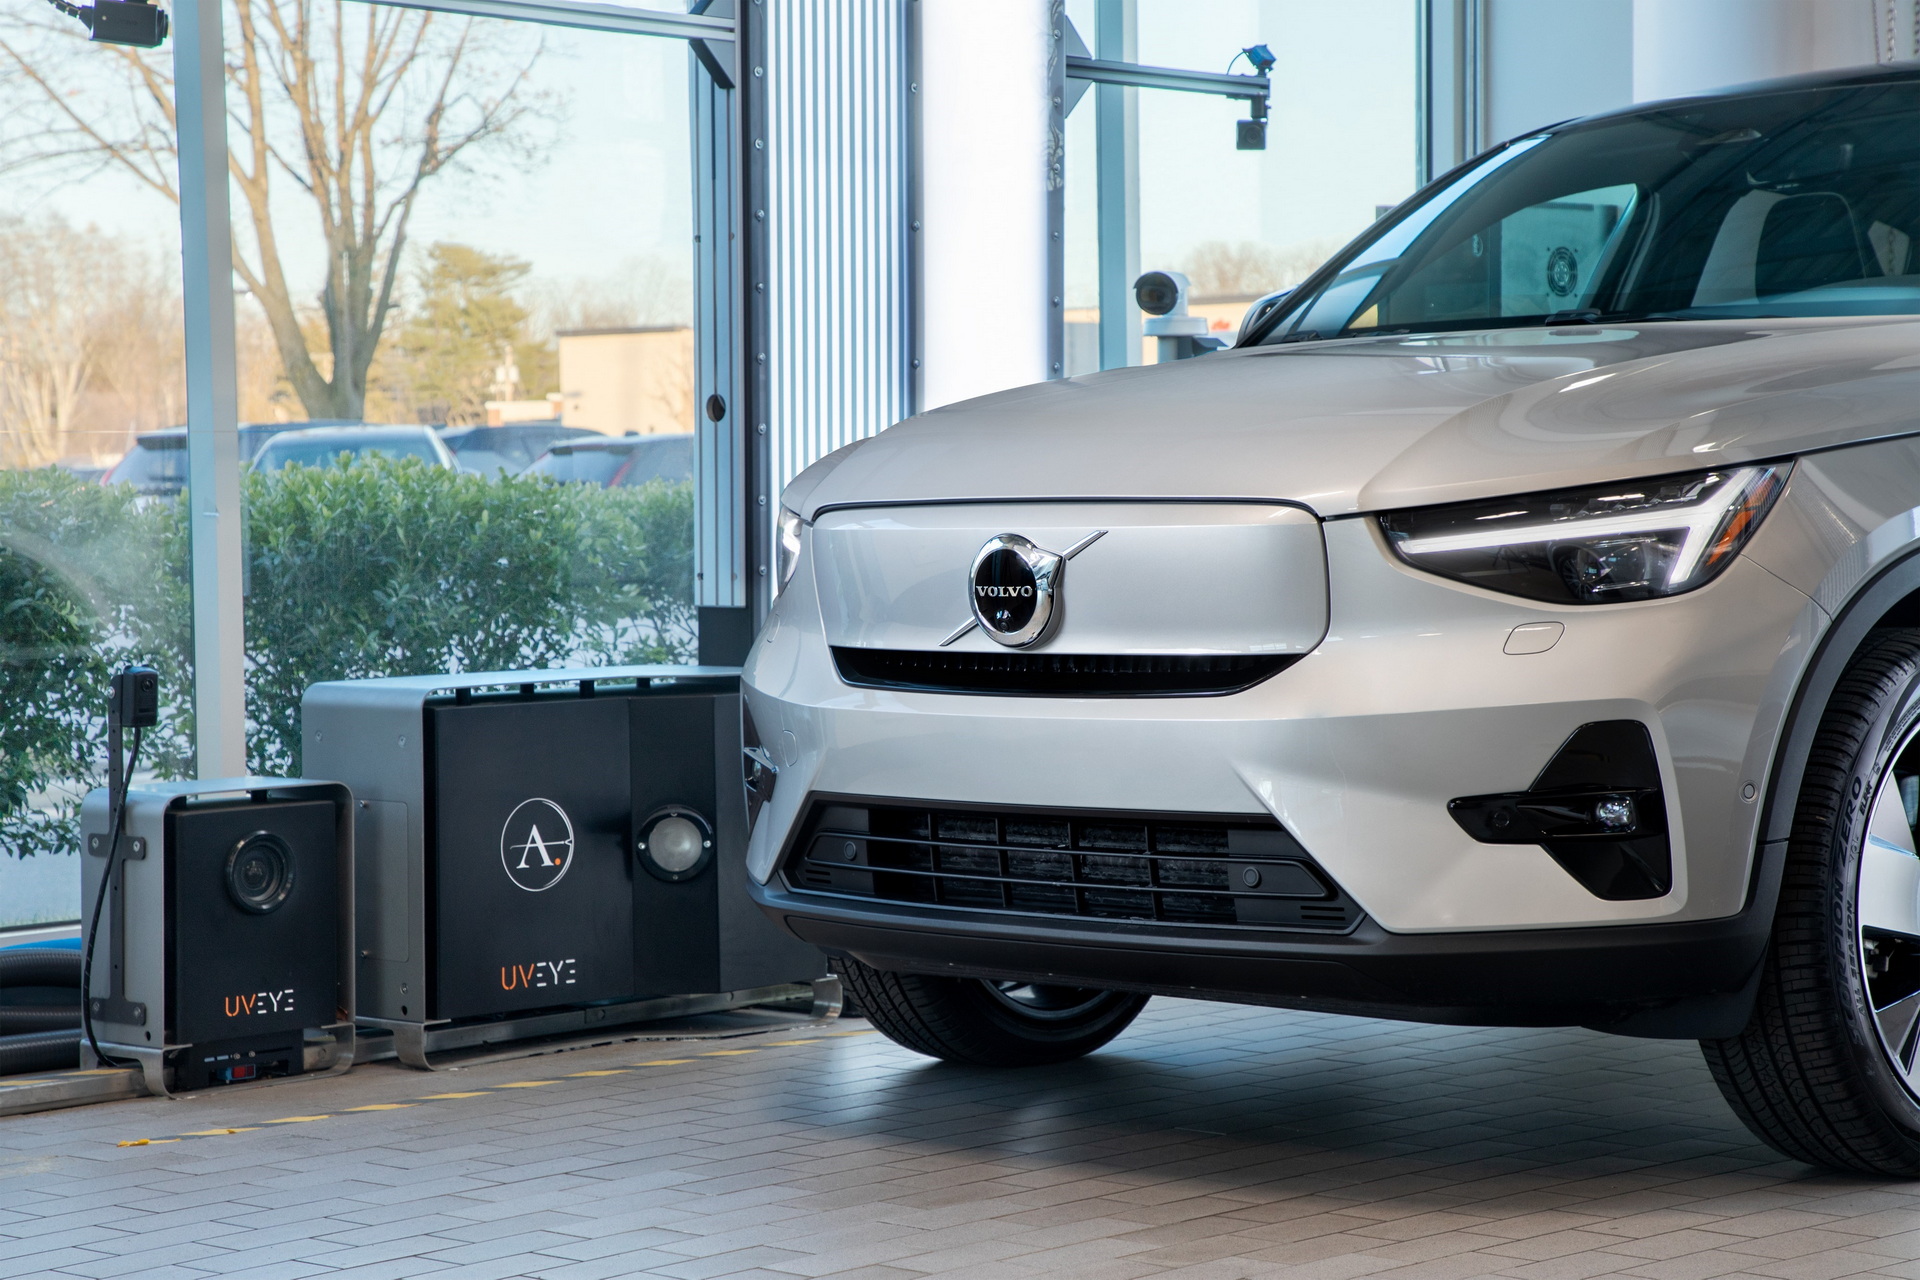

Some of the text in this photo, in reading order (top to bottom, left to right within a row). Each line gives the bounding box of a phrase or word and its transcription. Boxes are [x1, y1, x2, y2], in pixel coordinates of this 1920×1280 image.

[976, 585, 1033, 597] VOLVO
[1833, 776, 1864, 1046] SCORPION ZERO
[1846, 900, 1858, 980] SEASON
[501, 959, 576, 990] UVEYE
[225, 989, 294, 1017] UVEYE
